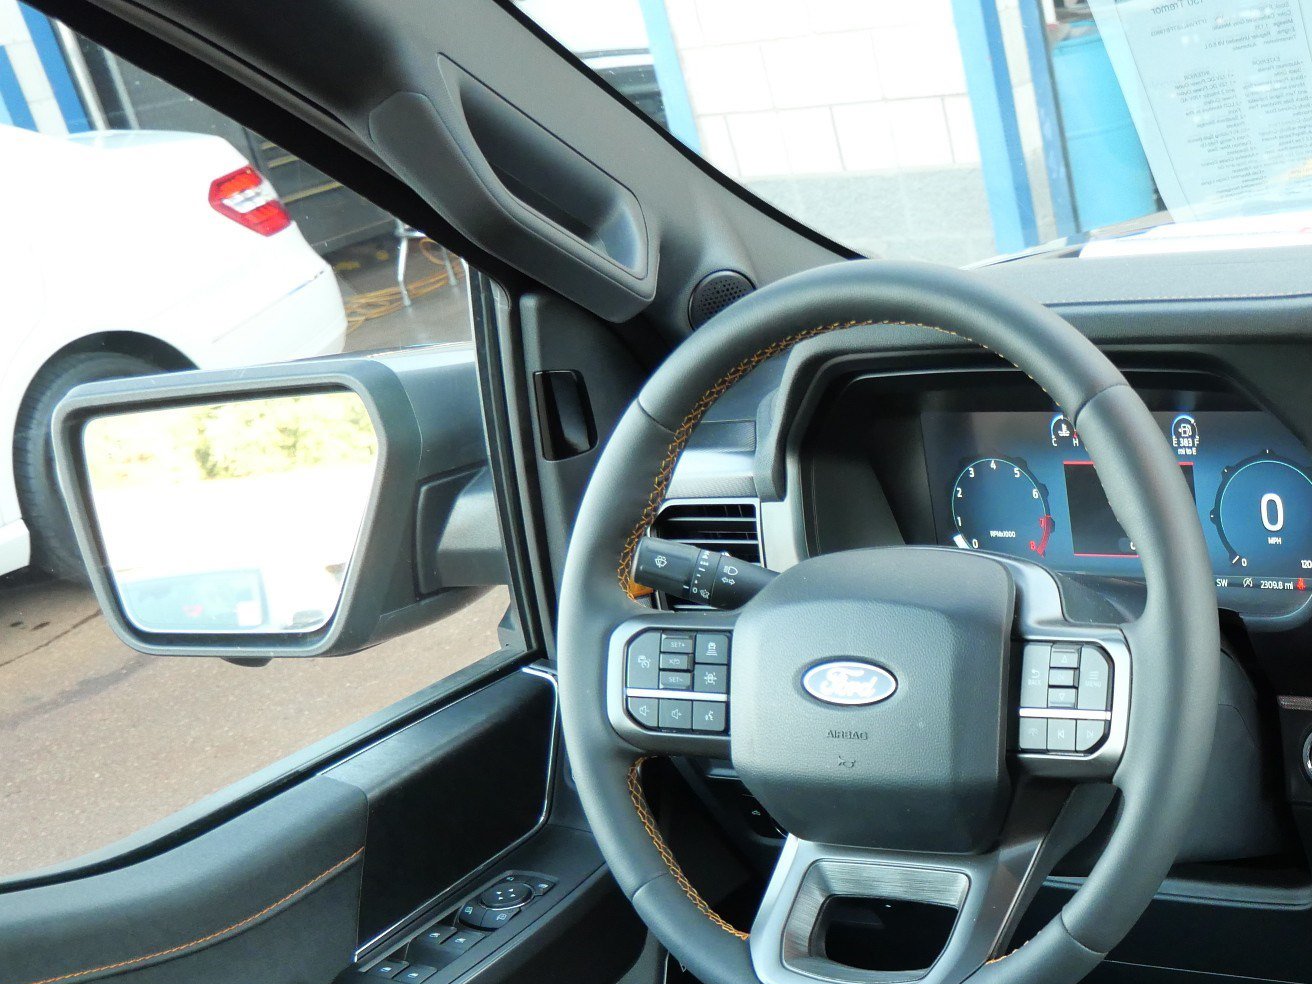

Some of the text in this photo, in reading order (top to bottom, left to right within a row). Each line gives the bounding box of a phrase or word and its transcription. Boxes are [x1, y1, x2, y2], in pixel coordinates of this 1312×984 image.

[1072, 438, 1079, 447] H
[1172, 438, 1178, 447] E
[990, 460, 996, 470] 4
[969, 468, 975, 478] 3
[1013, 468, 1020, 478] 5
[956, 487, 963, 498] 2
[1032, 489, 1038, 499] 6
[1261, 493, 1284, 531] 0
[957, 516, 962, 527] 1
[972, 538, 978, 549] 0
[1267, 537, 1282, 545] MPH
[1241, 558, 1248, 567] 0
[1301, 560, 1312, 569] 120
[1216, 579, 1294, 590] SW 2309.8 mi
[819, 668, 879, 698] Ford
[826, 730, 868, 740] AIRBAG
